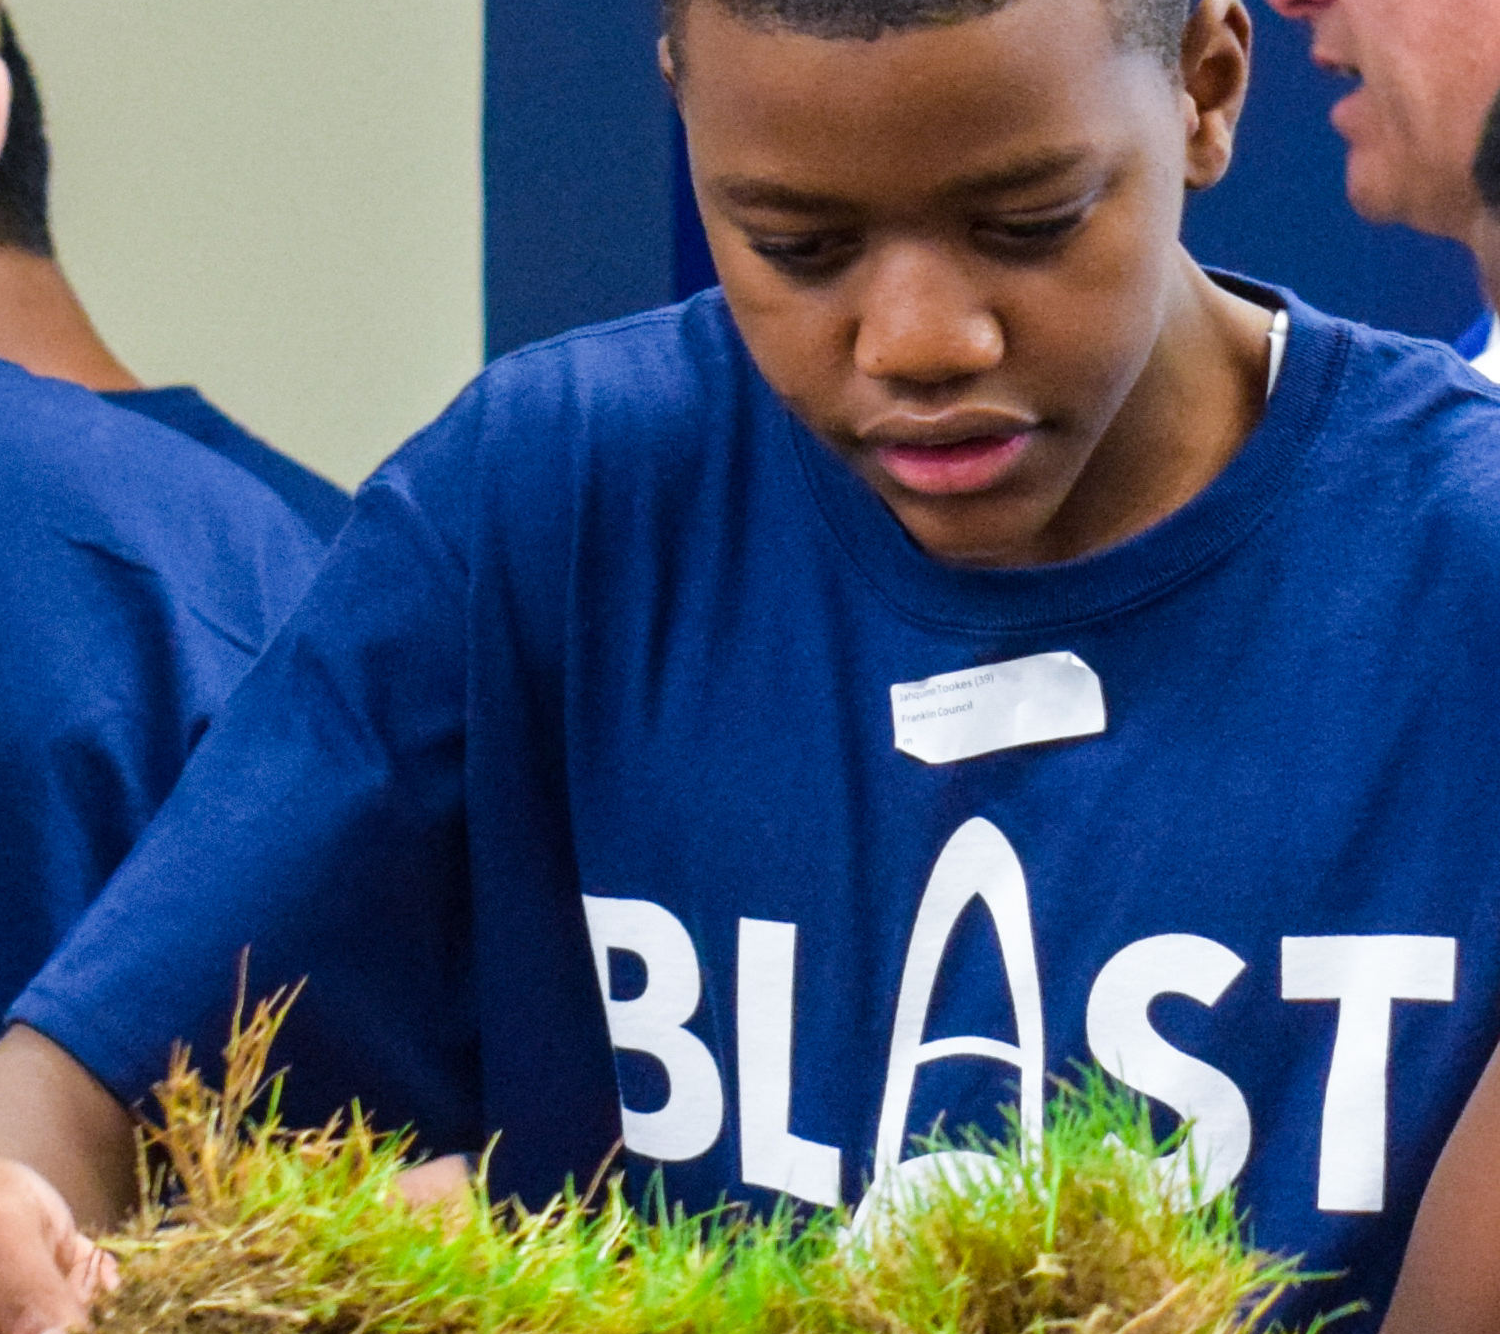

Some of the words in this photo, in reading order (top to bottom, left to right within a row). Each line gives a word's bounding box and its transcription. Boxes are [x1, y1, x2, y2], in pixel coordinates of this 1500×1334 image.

[901, 709, 937, 723] Franklin
[937, 700, 974, 718] Council
[581, 817, 1457, 1252] BLAST
